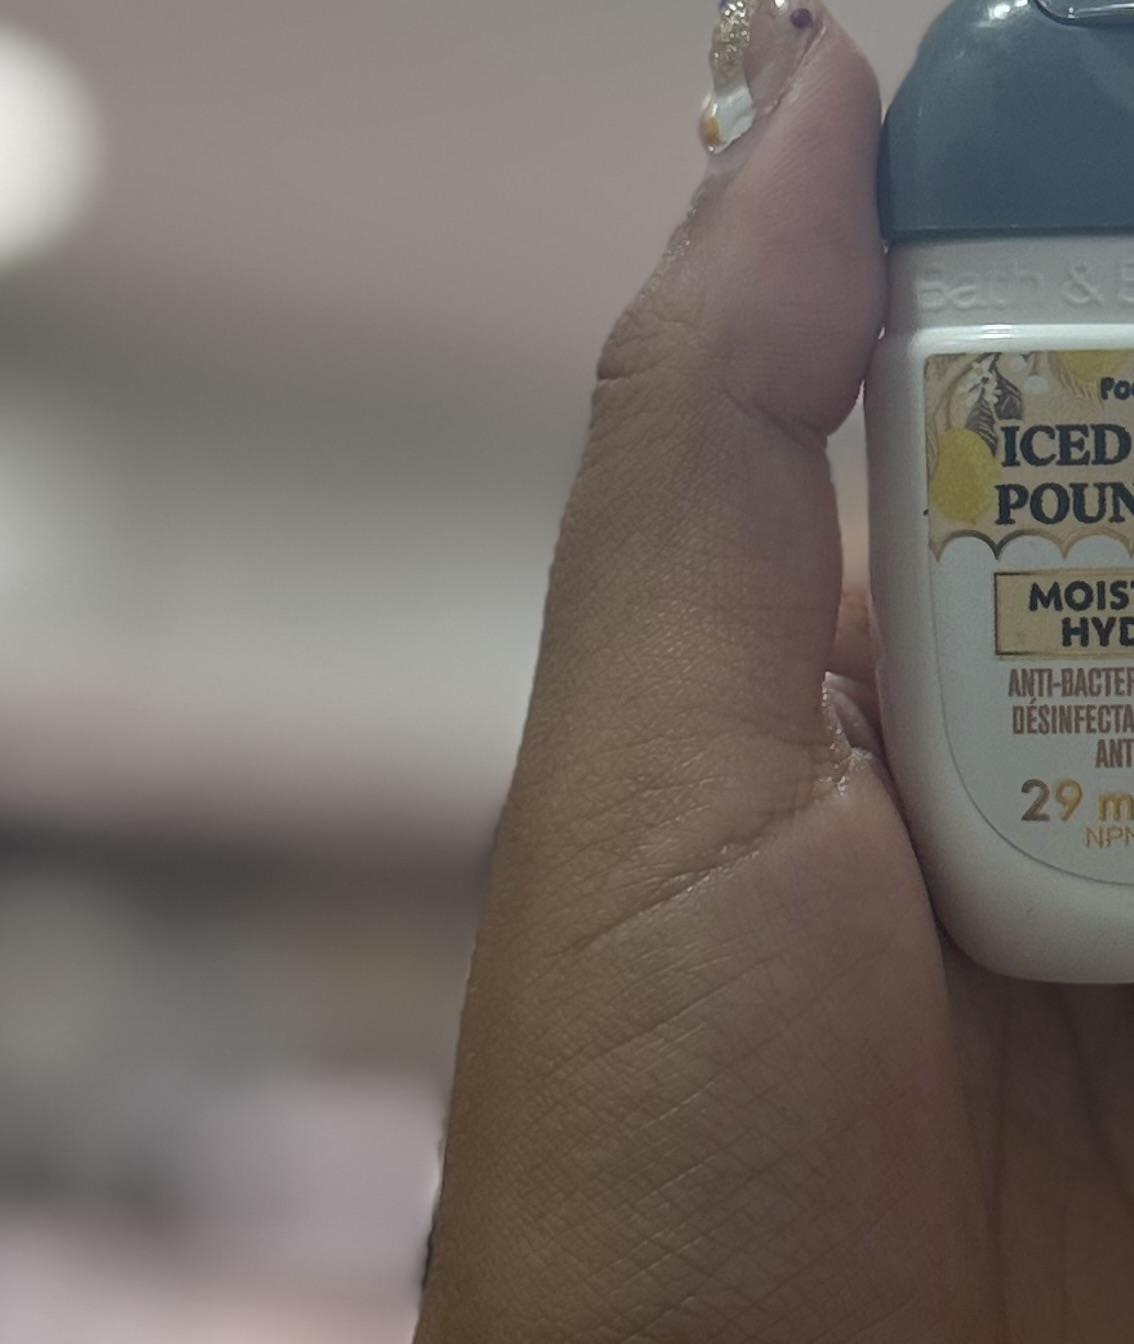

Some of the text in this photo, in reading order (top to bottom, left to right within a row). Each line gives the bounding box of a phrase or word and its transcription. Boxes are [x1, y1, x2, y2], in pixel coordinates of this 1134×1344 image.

[1061, 261, 1104, 305] &
[1000, 422, 1131, 468] ICED
[1020, 777, 1083, 823] 29
